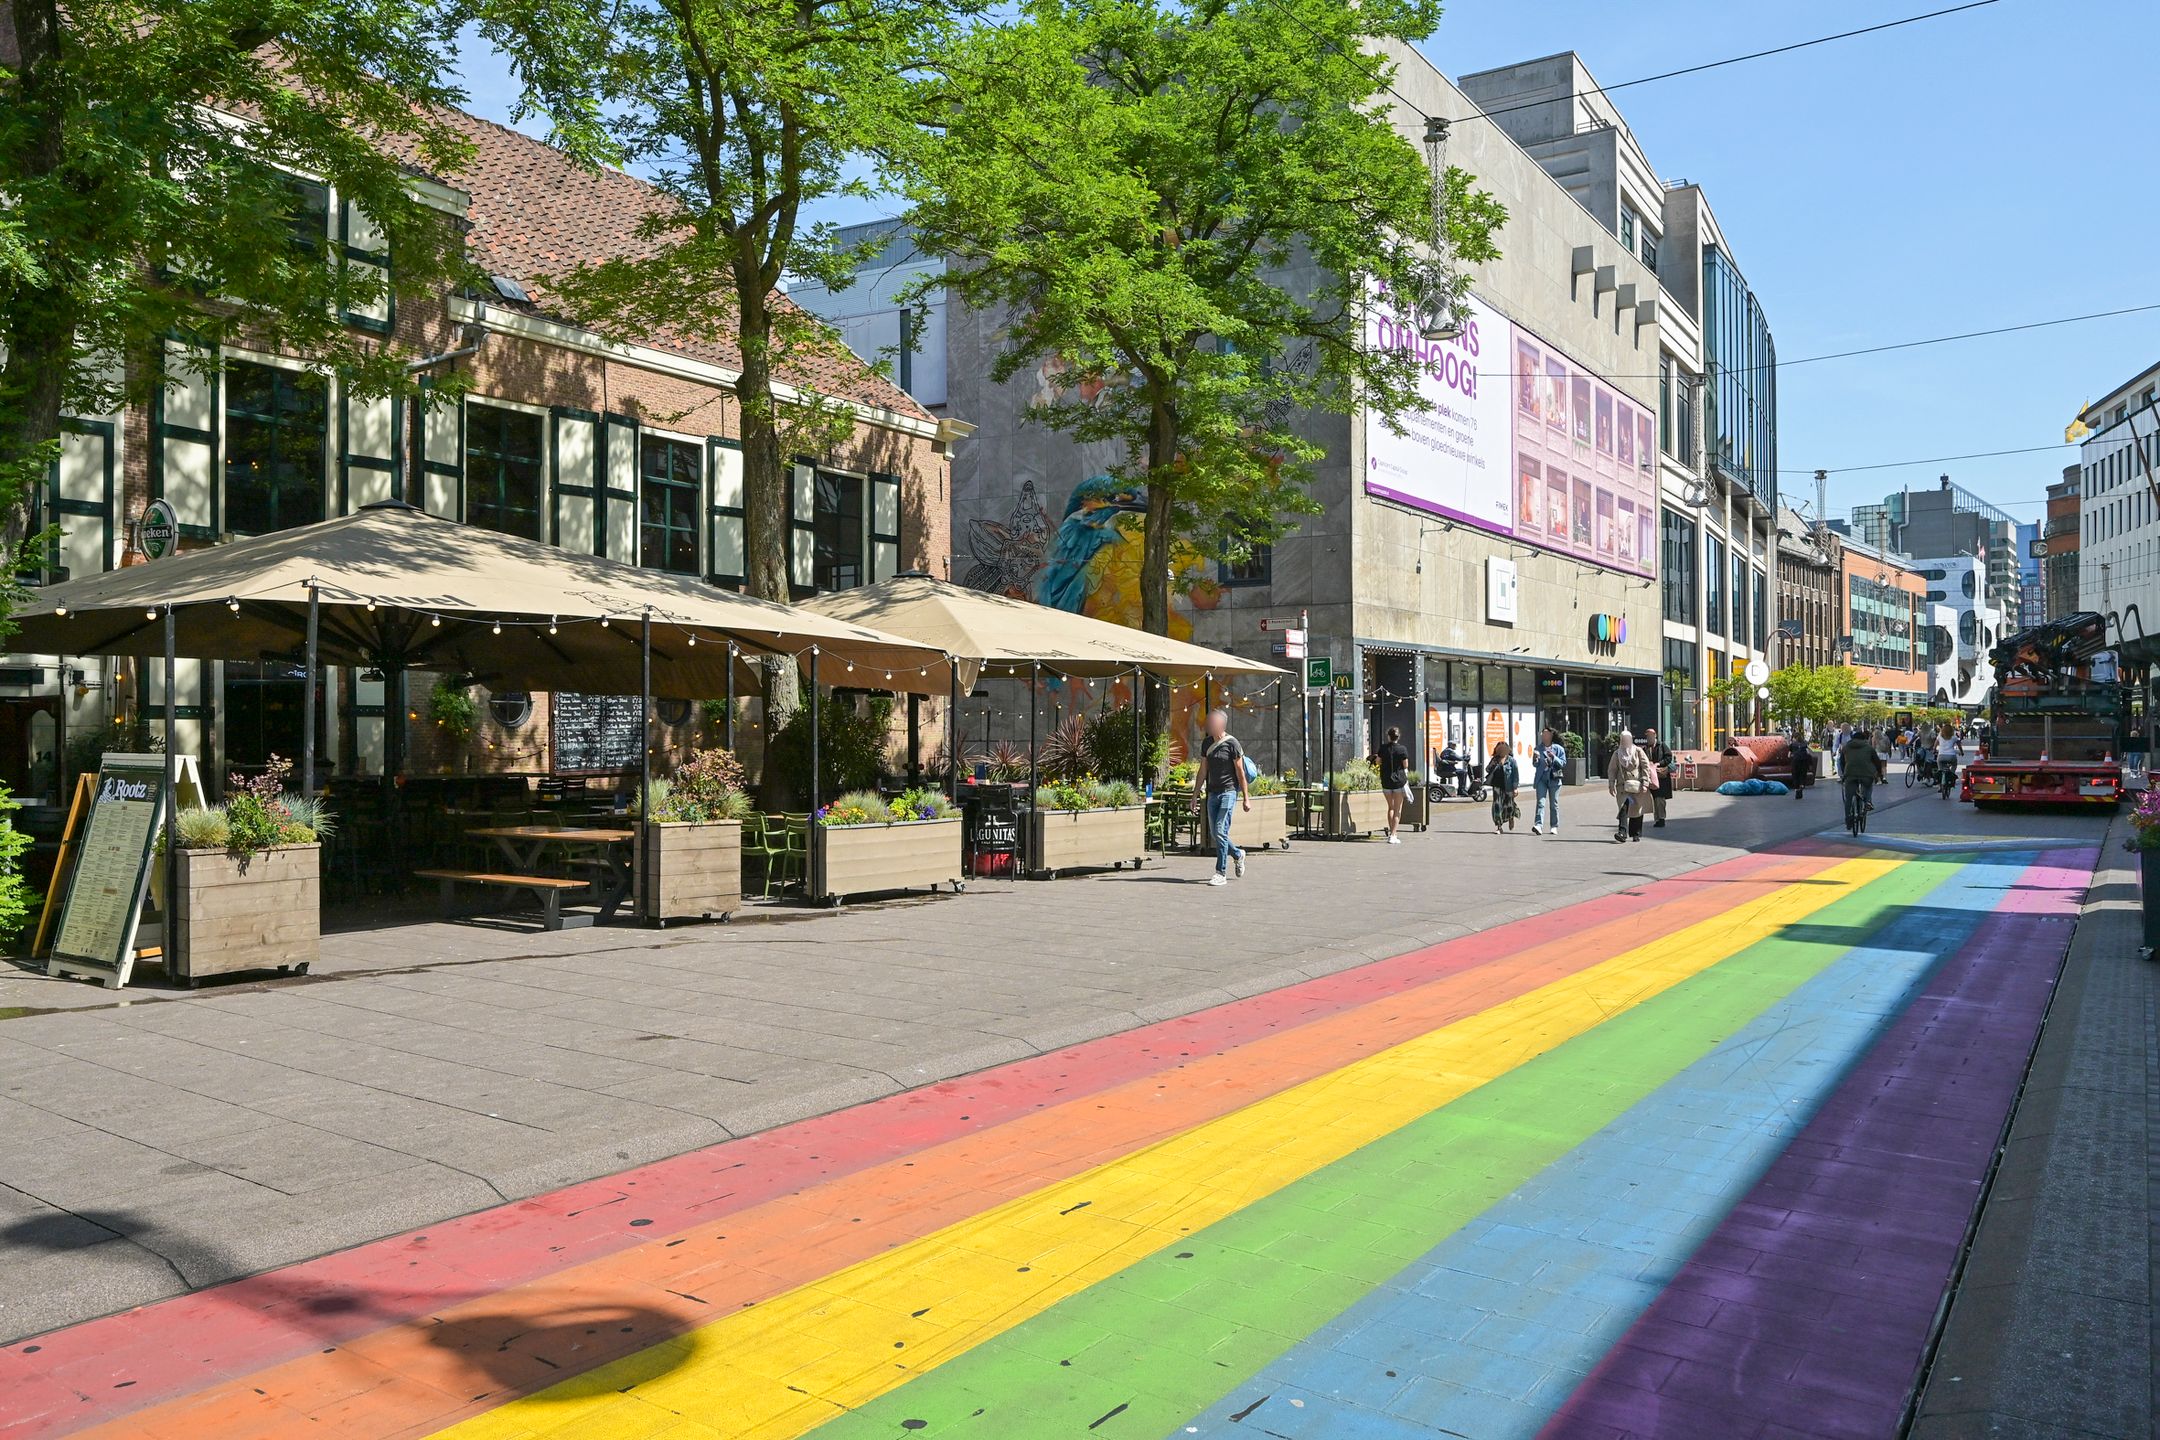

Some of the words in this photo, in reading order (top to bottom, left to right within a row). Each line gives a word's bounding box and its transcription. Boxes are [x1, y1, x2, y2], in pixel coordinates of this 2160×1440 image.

[1378, 315, 1477, 400] OMHOOG!
[1438, 403, 1451, 419] plek
[114, 778, 147, 799] Rootz
[970, 827, 1016, 842] LGUNITAS
